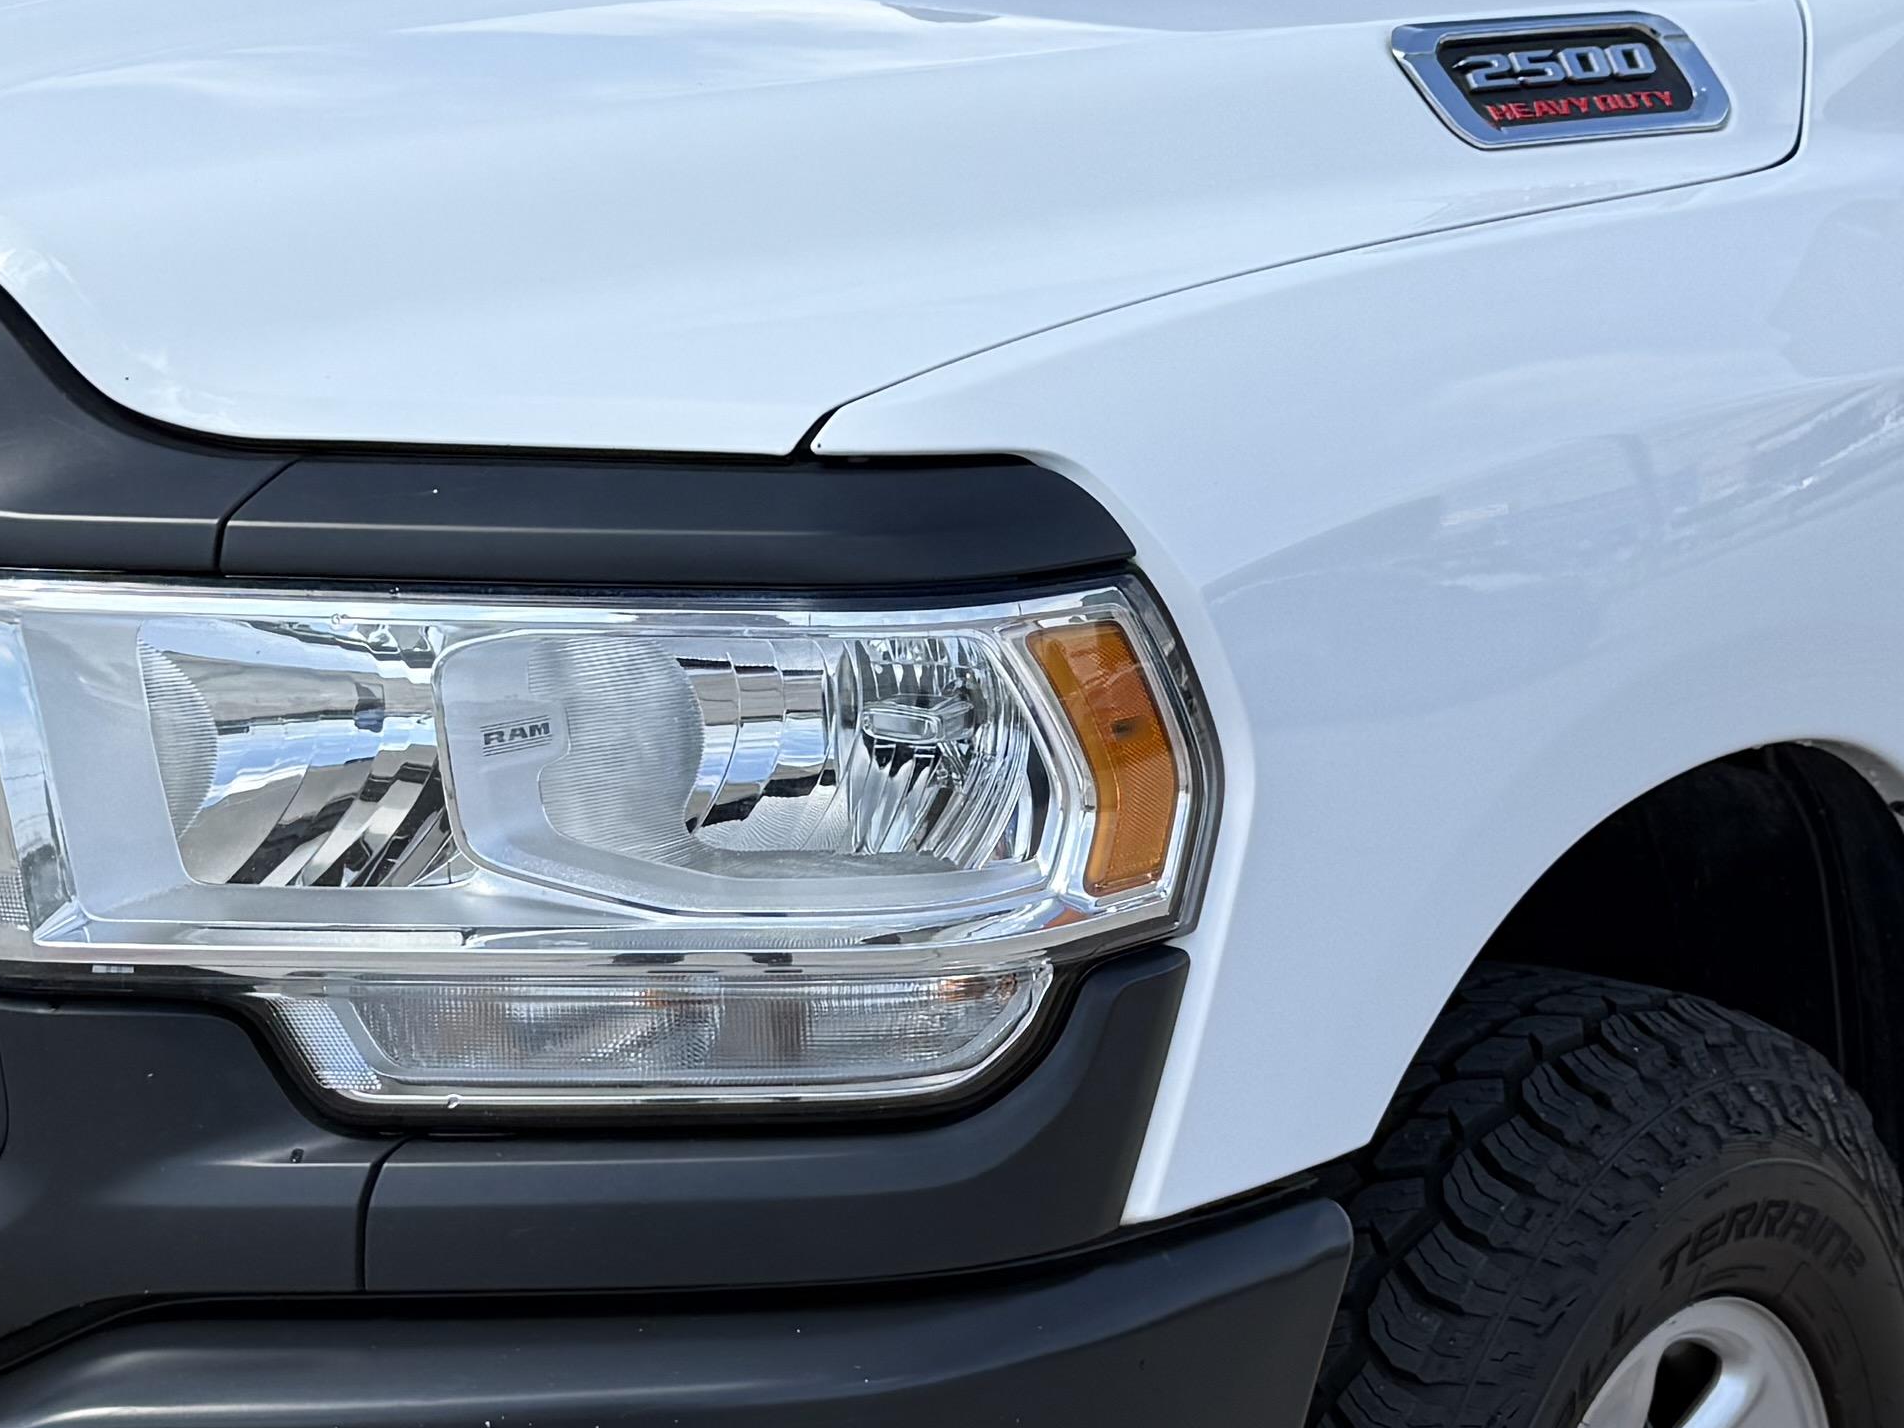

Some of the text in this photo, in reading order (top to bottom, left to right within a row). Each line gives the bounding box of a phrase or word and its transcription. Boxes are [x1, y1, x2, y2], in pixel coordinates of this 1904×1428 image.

[1452, 42, 1656, 93] 2500
[1485, 90, 1673, 122] HEAVY DUTY
[483, 722, 551, 746] RAM
